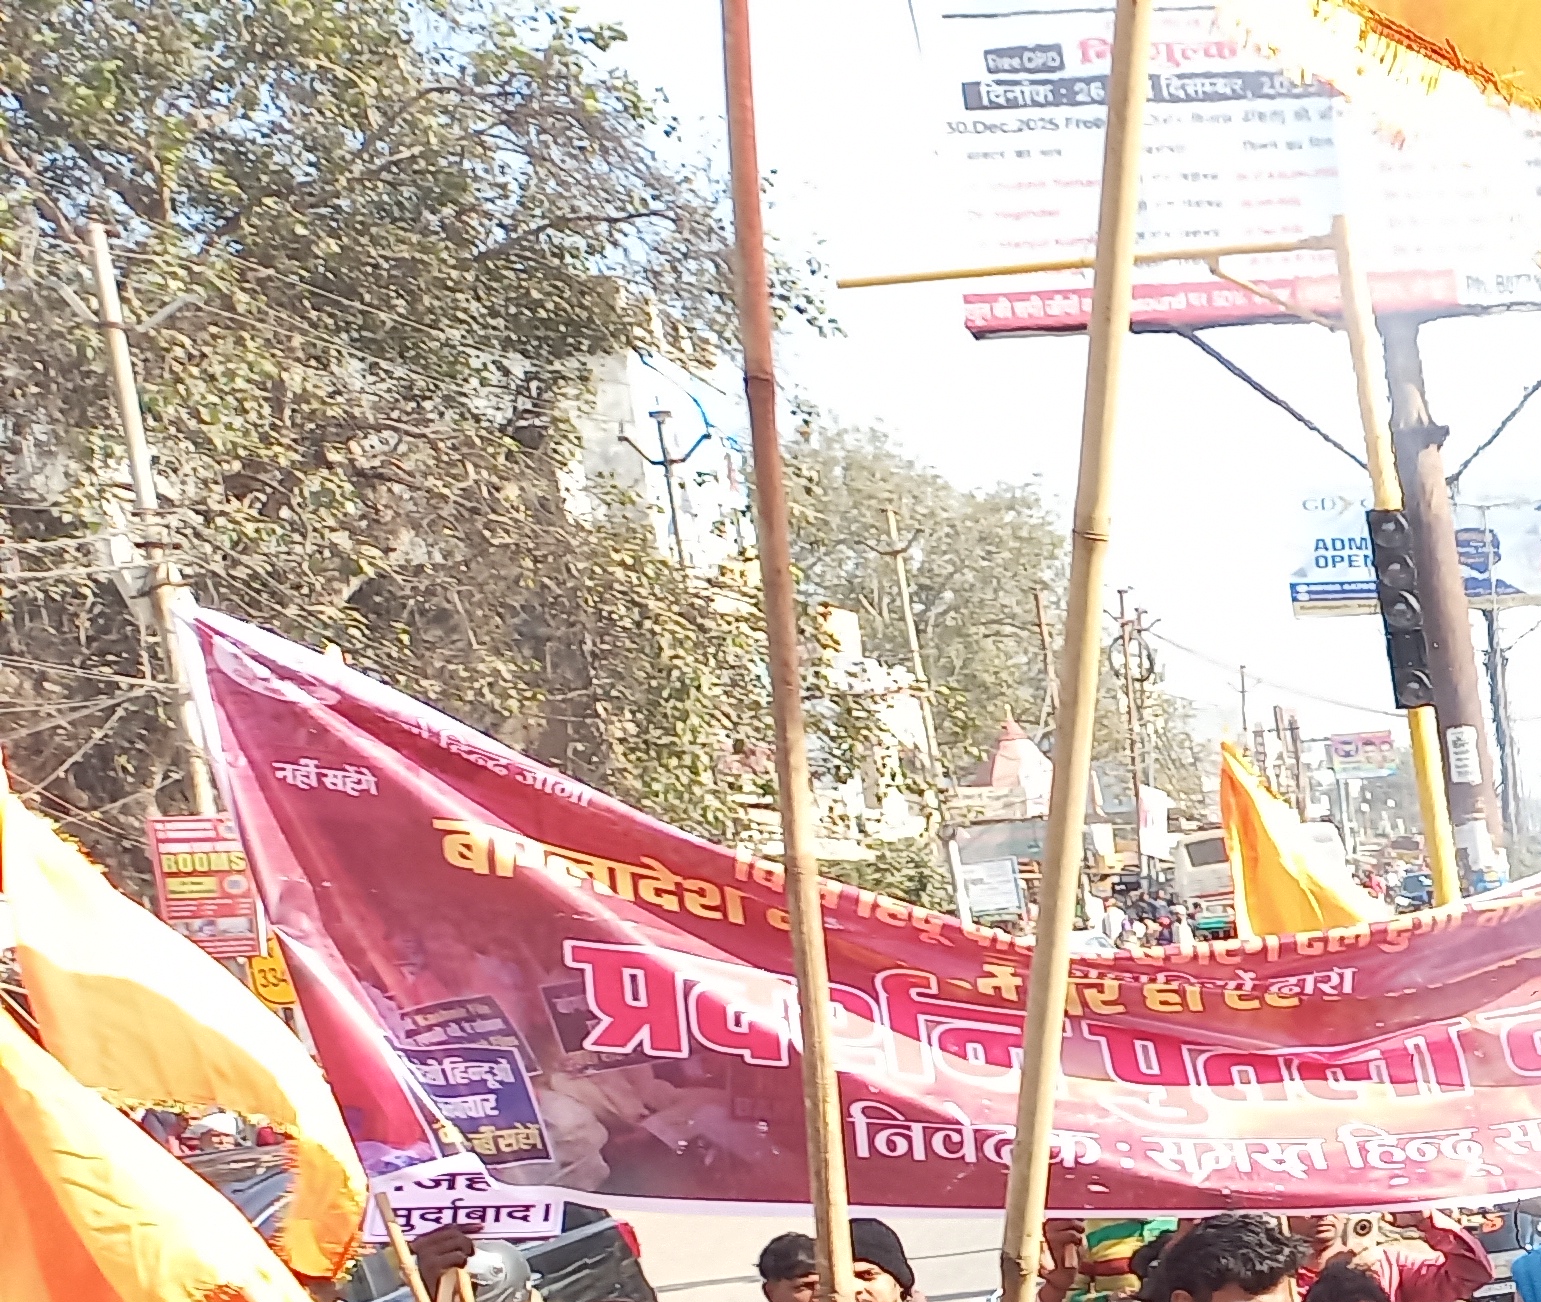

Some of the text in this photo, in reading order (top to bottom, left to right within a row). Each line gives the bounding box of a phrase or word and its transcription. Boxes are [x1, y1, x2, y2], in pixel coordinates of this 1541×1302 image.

[161, 852, 247, 873] ROOMS
[1140, 1131, 1326, 1182] समस्त
[1340, 1117, 1505, 1178] हिन्दू
